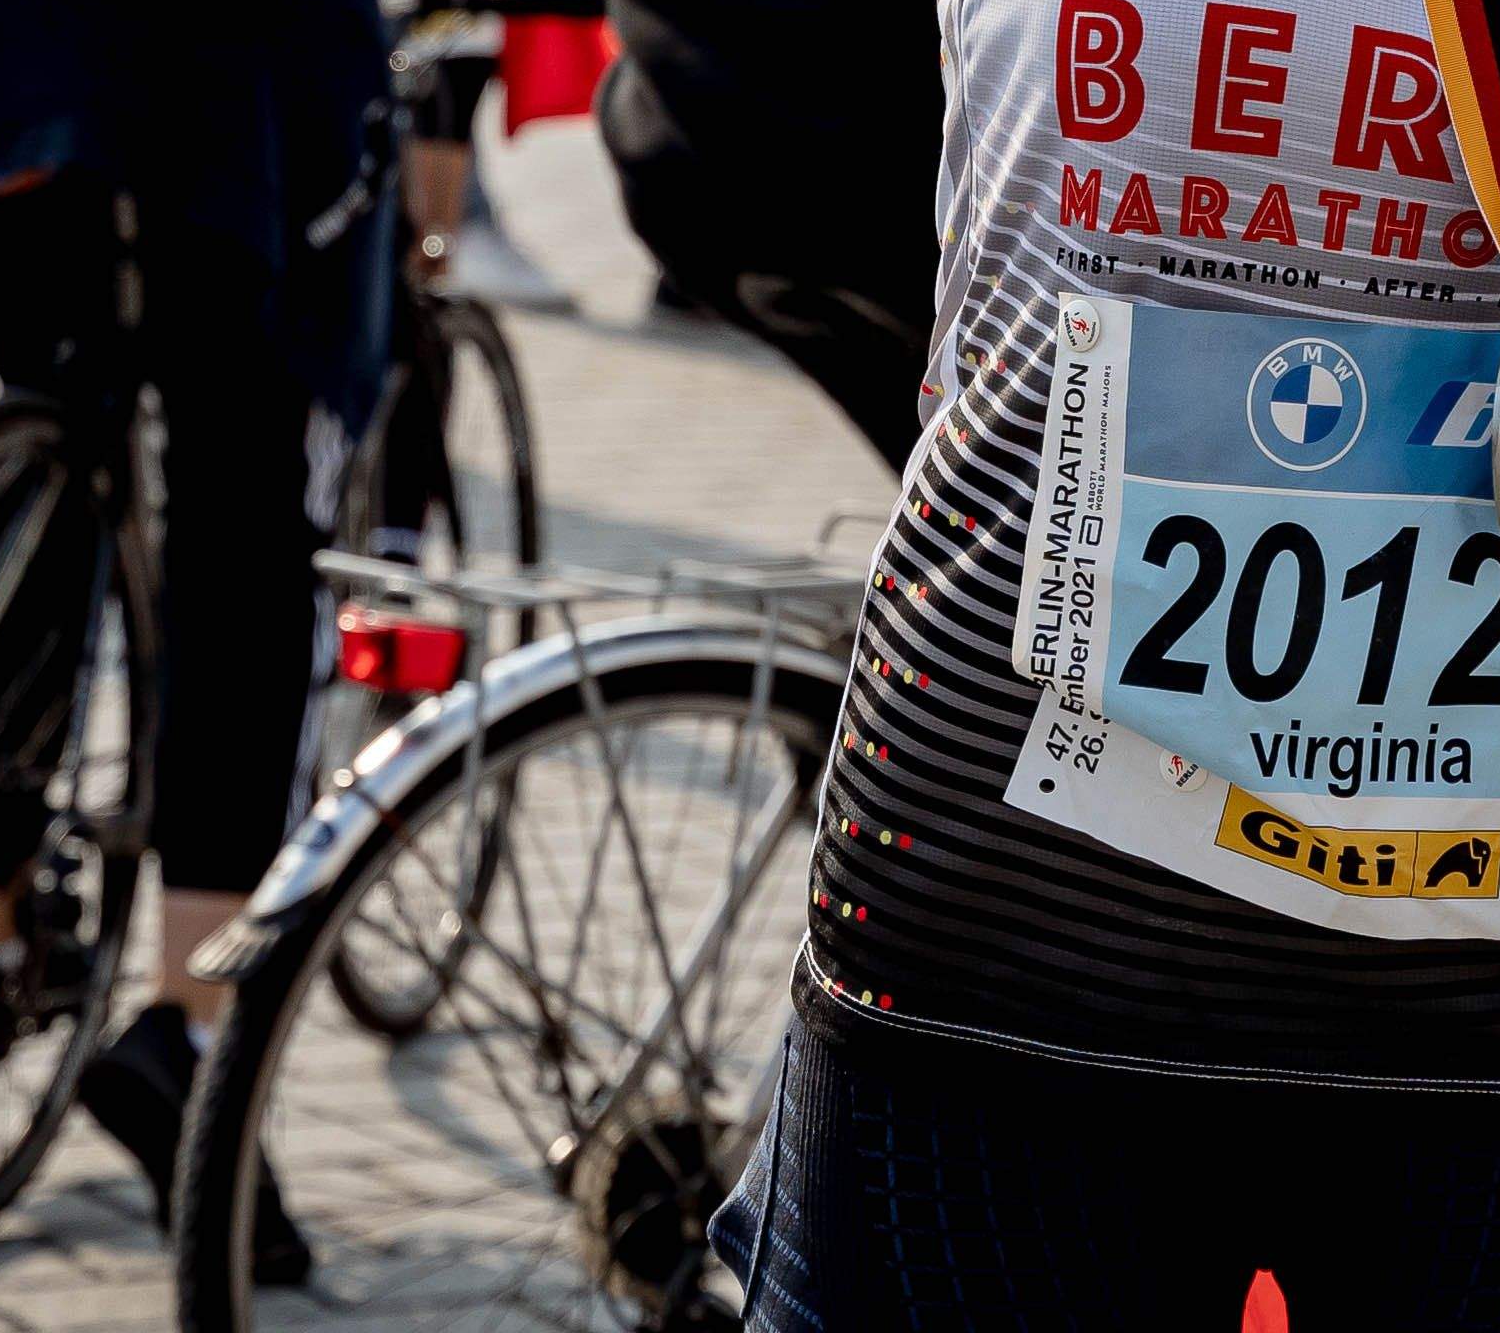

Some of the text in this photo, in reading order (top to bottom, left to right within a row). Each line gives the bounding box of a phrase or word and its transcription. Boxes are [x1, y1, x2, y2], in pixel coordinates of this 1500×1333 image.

[1159, 256, 1321, 290] MARATHON
[1363, 276, 1455, 303] AFTER
[1266, 345, 1354, 382] BMW
[1095, 365, 1112, 511] WORLD MARATHON MAJORS
[1087, 470, 1098, 511] ABBOTT
[1068, 556, 1096, 628] 2021
[1046, 722, 1079, 761] 47.
[1074, 731, 1108, 774] 26.
[1250, 719, 1473, 798] virginia
[1240, 810, 1397, 887] Giti
